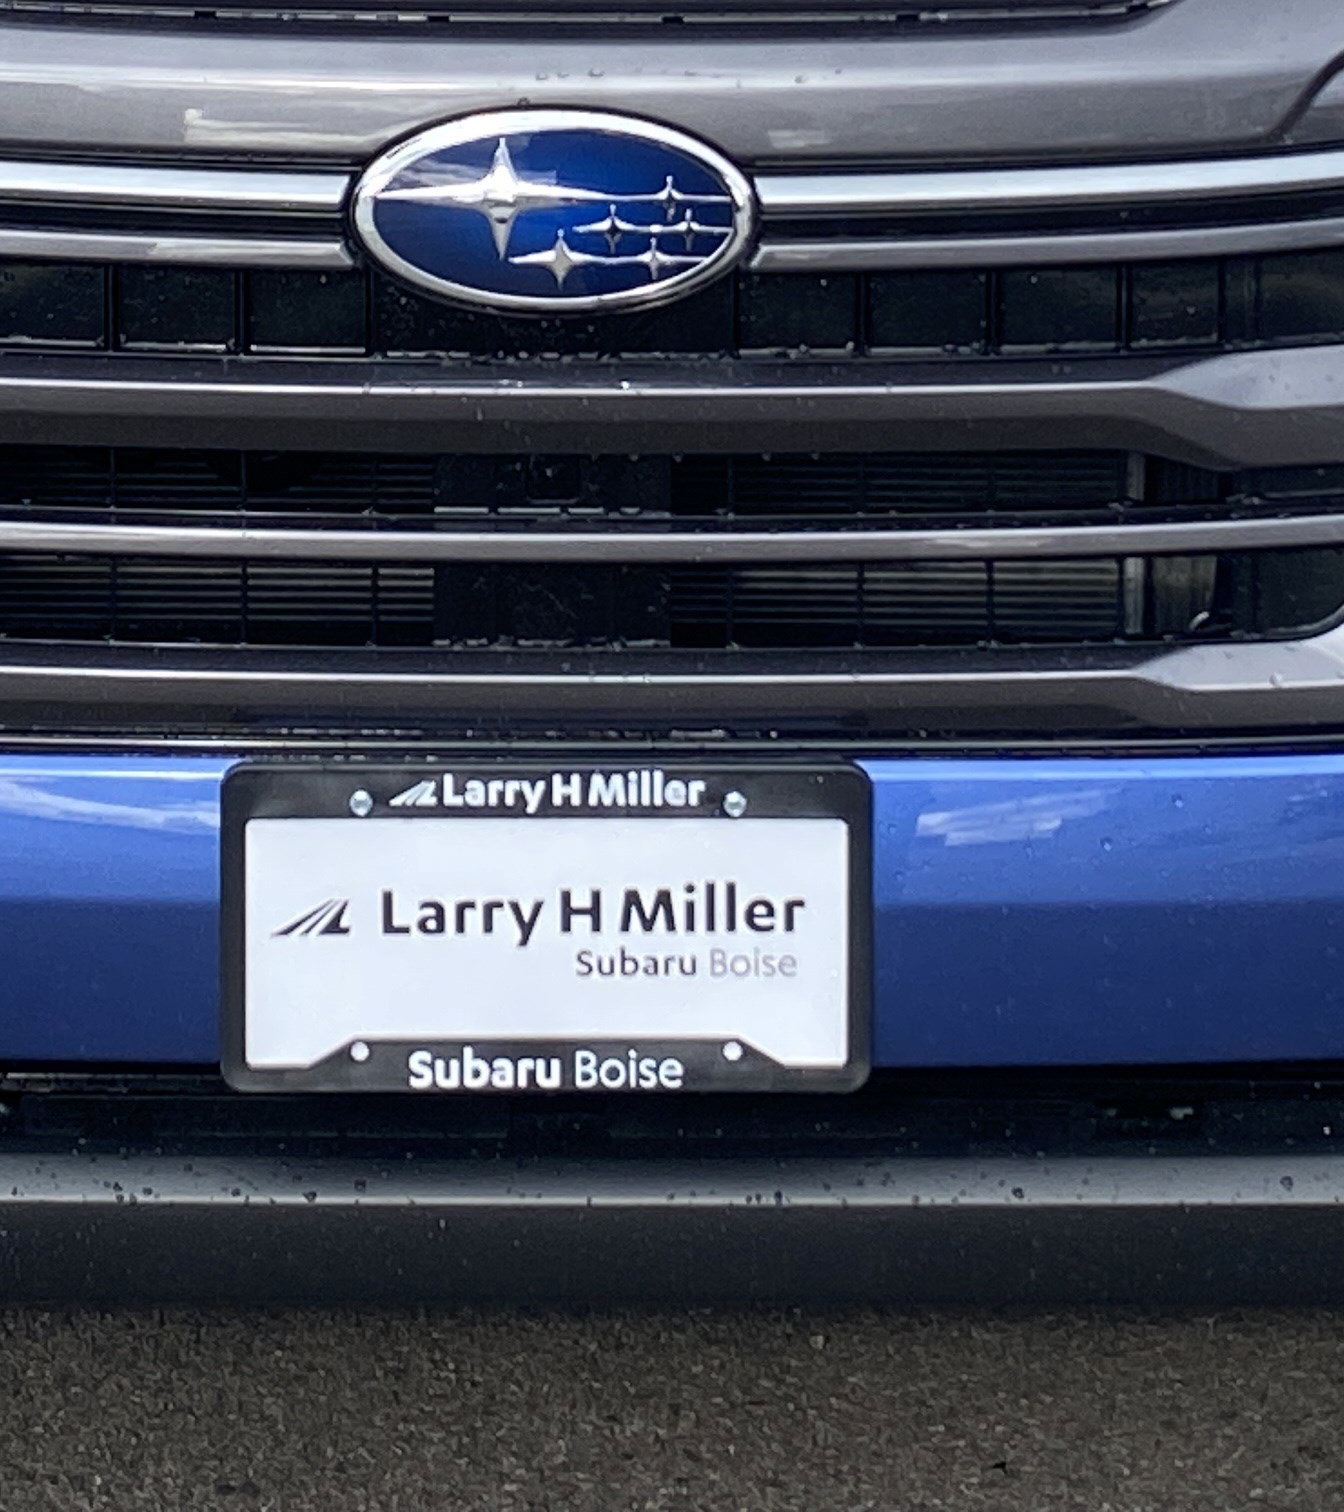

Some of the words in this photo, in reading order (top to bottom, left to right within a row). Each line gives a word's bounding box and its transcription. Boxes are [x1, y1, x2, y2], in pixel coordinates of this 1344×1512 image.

[443, 773, 545, 813] Larry
[551, 774, 581, 807] H
[587, 770, 706, 807] Miller
[382, 889, 544, 947] Larry
[560, 889, 602, 933] H
[619, 881, 806, 933] Miller
[576, 947, 697, 977] Subaru
[709, 949, 797, 978] Boise
[408, 1046, 561, 1090] Subaru
[574, 1048, 684, 1089] Boise
